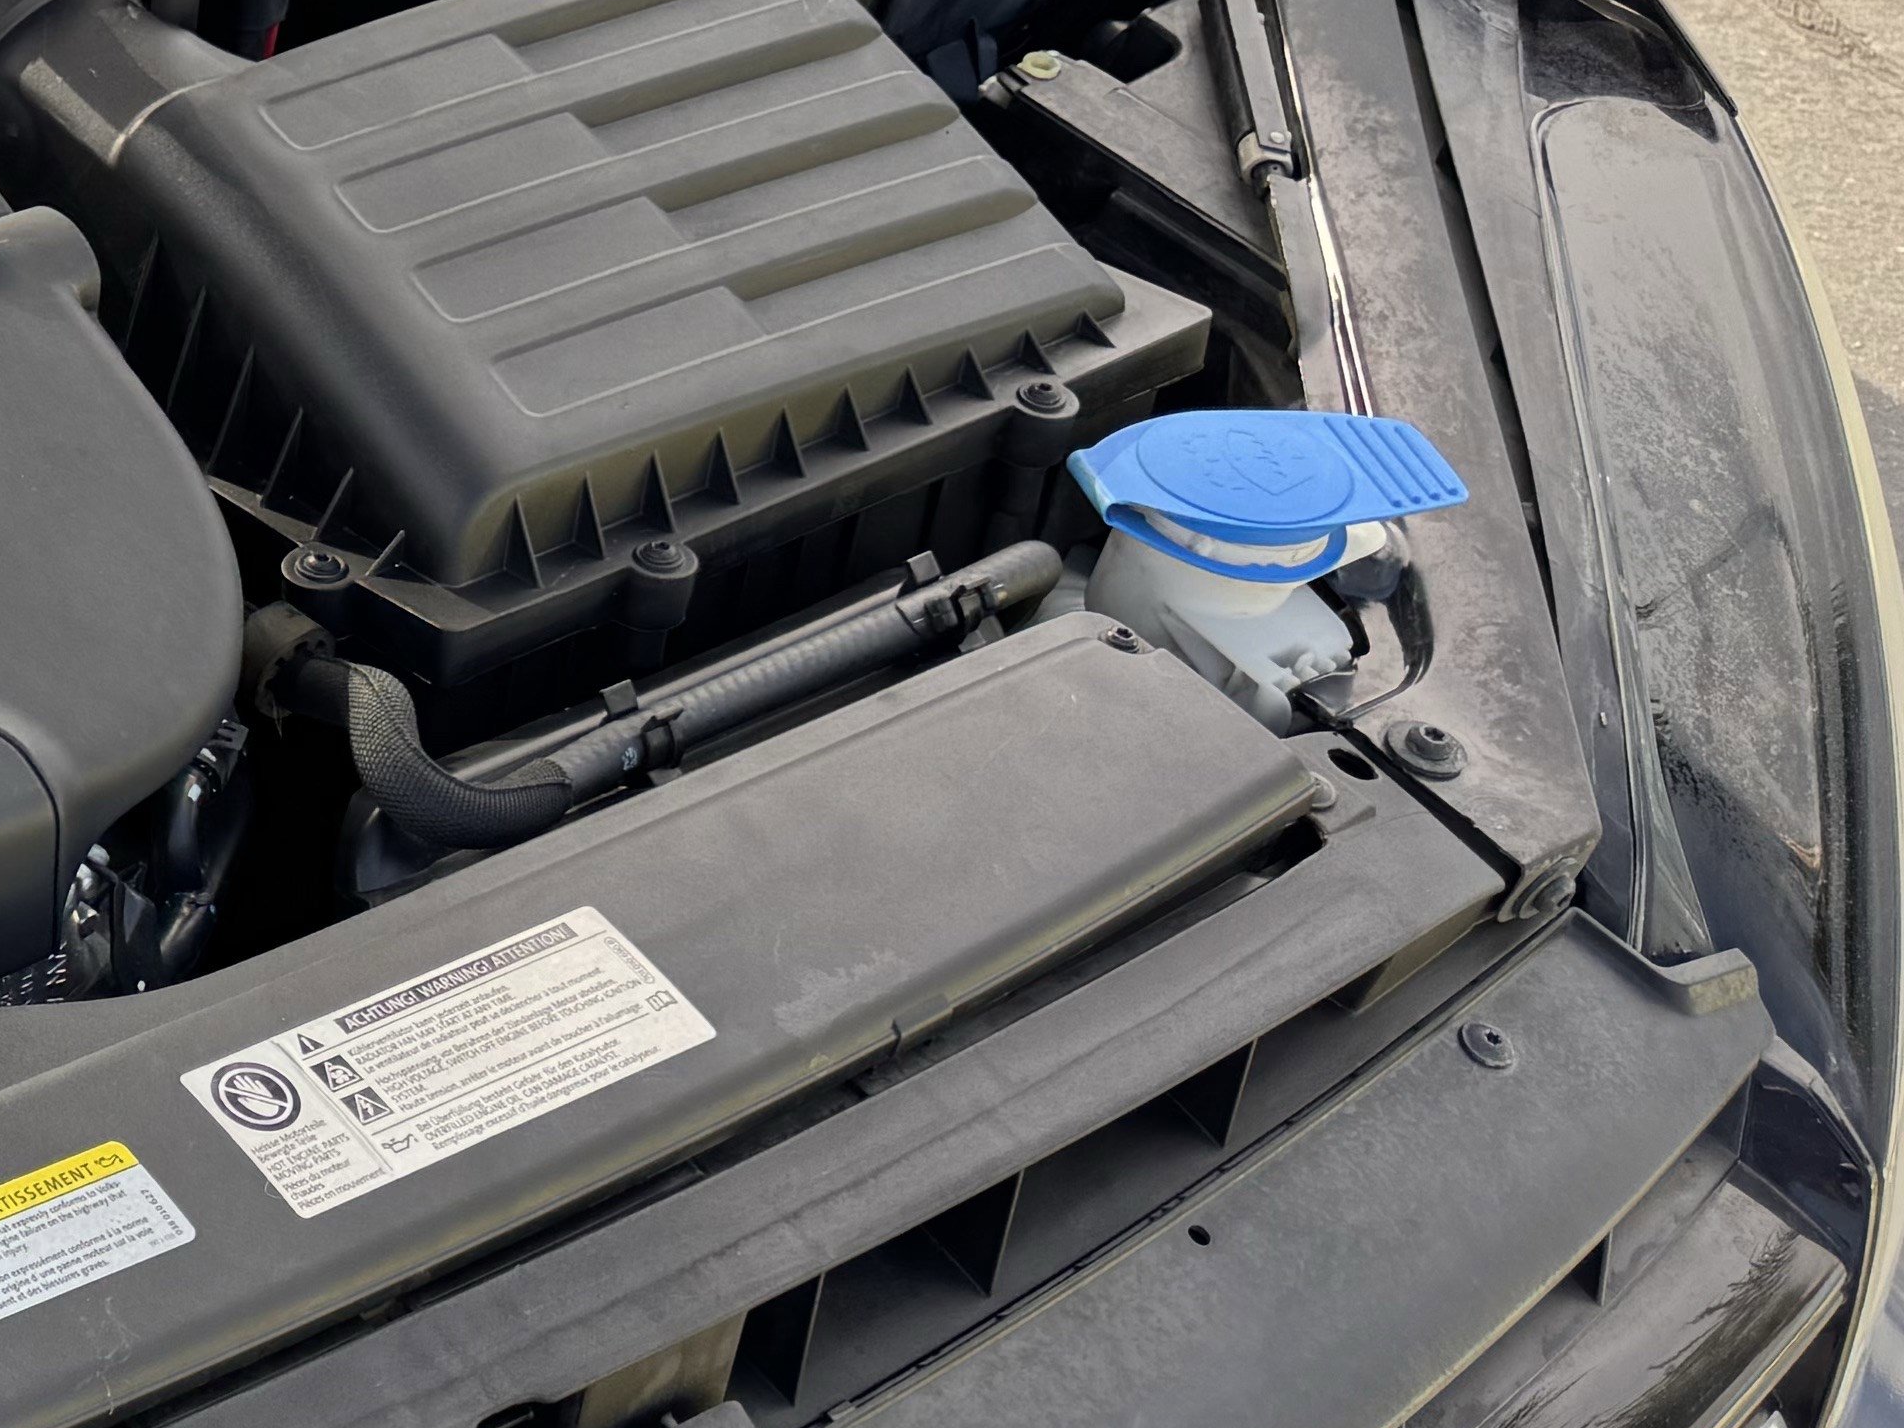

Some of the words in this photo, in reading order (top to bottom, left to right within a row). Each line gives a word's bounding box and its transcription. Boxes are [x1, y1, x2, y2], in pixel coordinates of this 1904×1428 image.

[341, 988, 420, 1030] ACHTUNG!
[415, 958, 493, 999] WARNING!
[487, 925, 571, 968] ATTENTION!
[414, 1025, 437, 1040] MAY
[435, 1014, 462, 1031] START
[10, 1207, 50, 1231] expressly
[47, 1192, 86, 1214] conforms
[84, 1188, 97, 1199] to
[19, 1221, 47, 1238] failure
[46, 1217, 60, 1227] on
[57, 1210, 73, 1223] the
[72, 1196, 110, 1219] highway
[107, 1188, 127, 1202] that
[139, 1186, 158, 1206] 627
[154, 1203, 171, 1221] 010
[65, 1230, 105, 1253] conforme
[109, 1224, 122, 1234] la
[120, 1214, 148, 1231] norme
[167, 1218, 184, 1236] 018
[55, 1255, 83, 1273] panne
[80, 1240, 112, 1260] moteur
[111, 1236, 126, 1247] sur
[123, 1231, 135, 1241] la
[133, 1223, 152, 1237] voie
[13, 1290, 27, 1301] et
[24, 1283, 42, 1297] des
[40, 1267, 79, 1290] blessures
